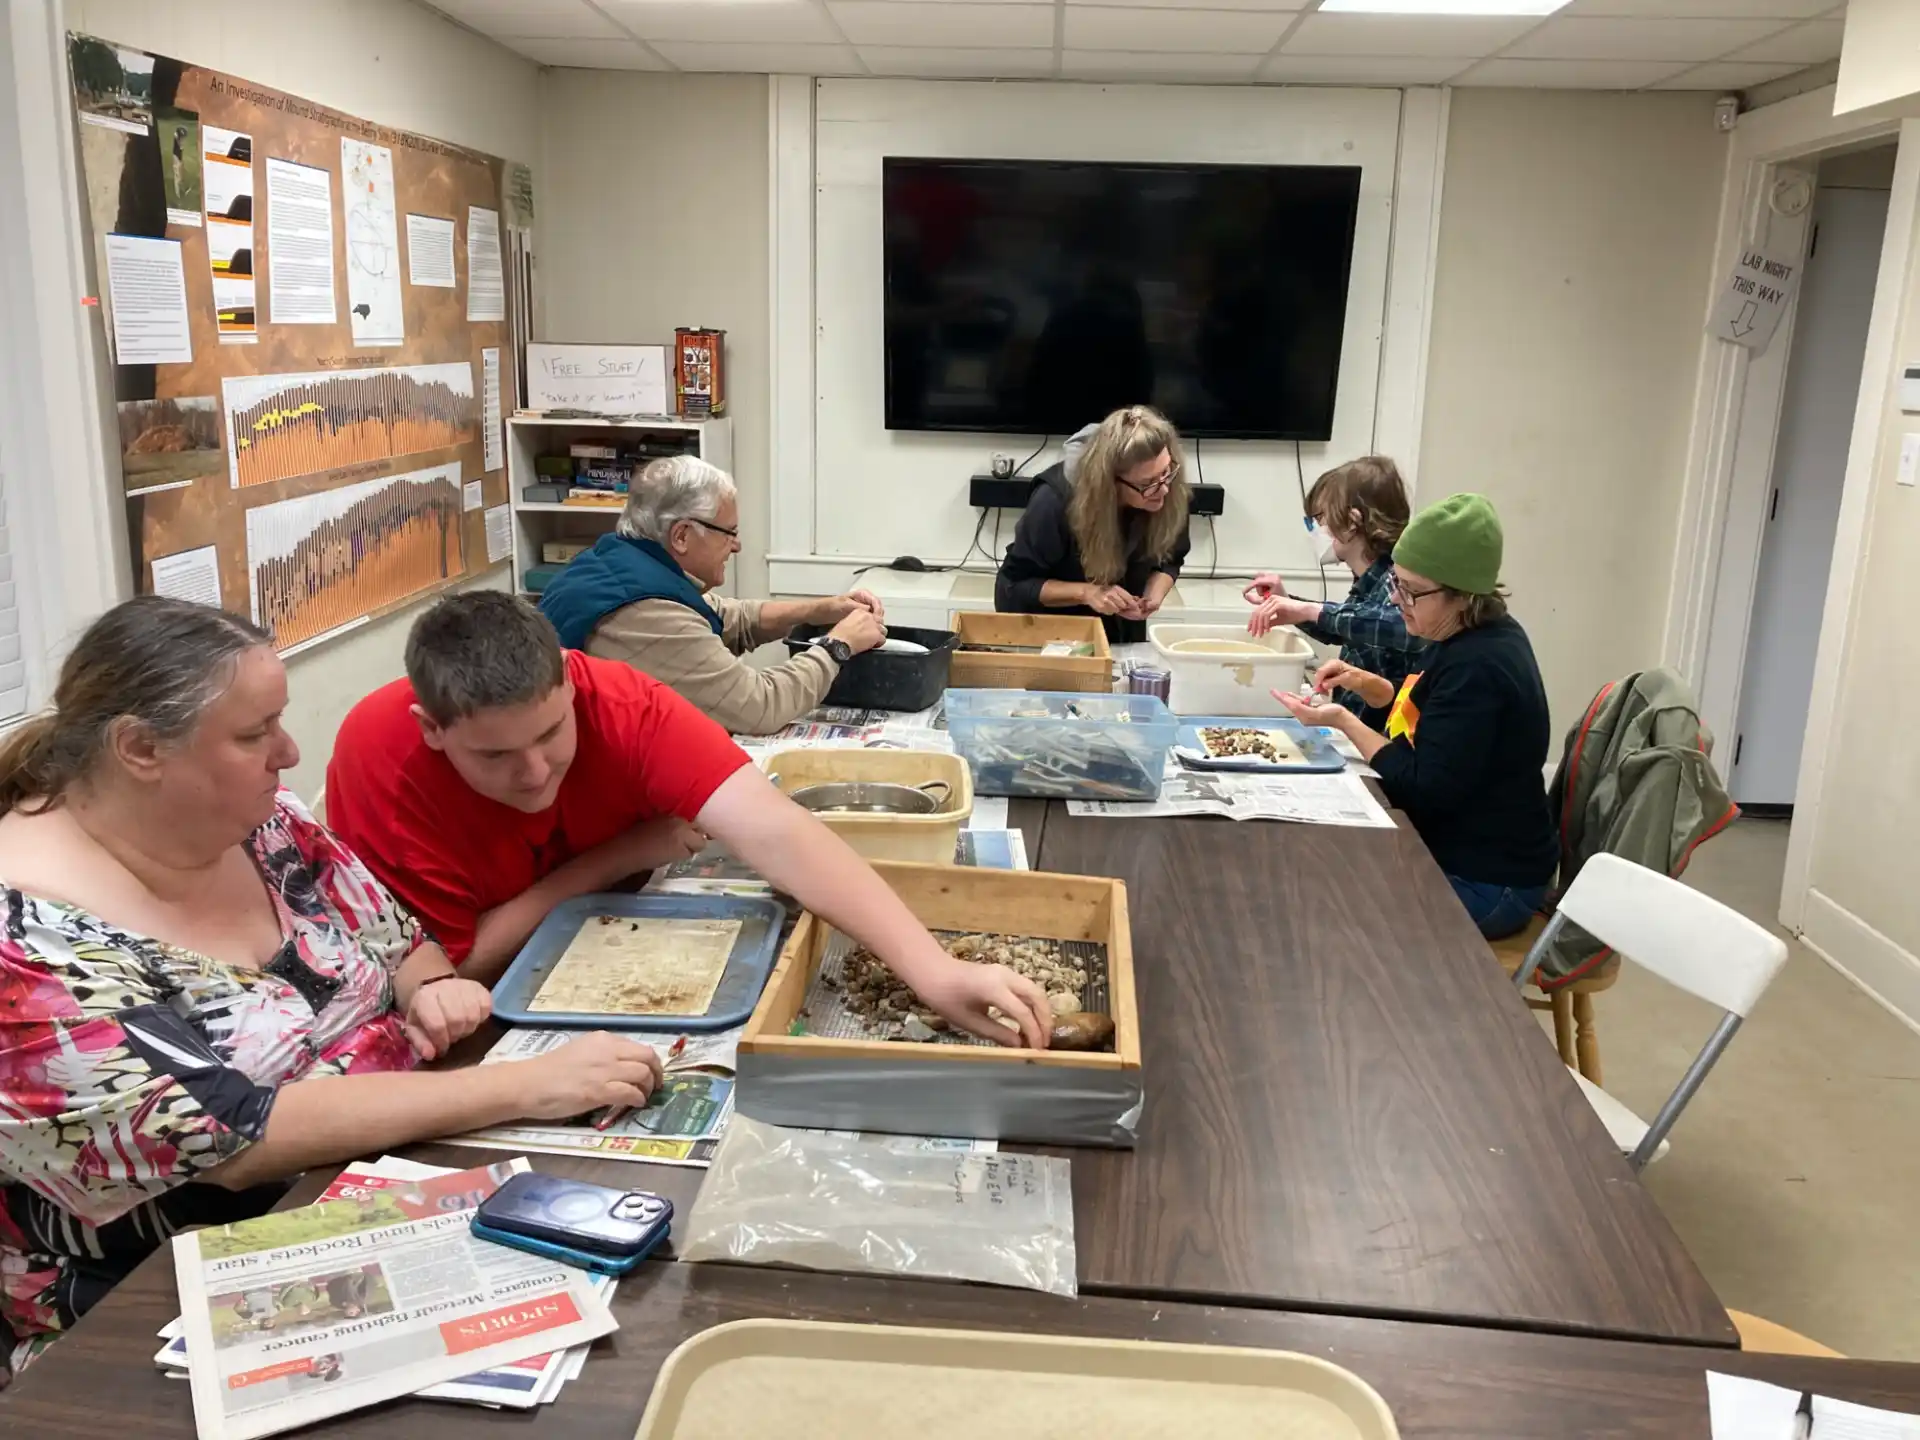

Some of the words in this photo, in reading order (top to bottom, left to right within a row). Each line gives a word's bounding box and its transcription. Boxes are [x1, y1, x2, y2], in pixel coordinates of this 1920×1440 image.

[210, 75, 225, 93] An
[225, 79, 277, 107] Investigation
[1741, 251, 1764, 271] LAB
[1762, 259, 1793, 281] NIGHT
[1732, 275, 1756, 296] THIS
[1757, 284, 1785, 305] WAY
[212, 1256, 260, 1272] star
[333, 1311, 410, 1338] fighting
[458, 1301, 561, 1338] SPORTS
[260, 1331, 330, 1353] cancer
